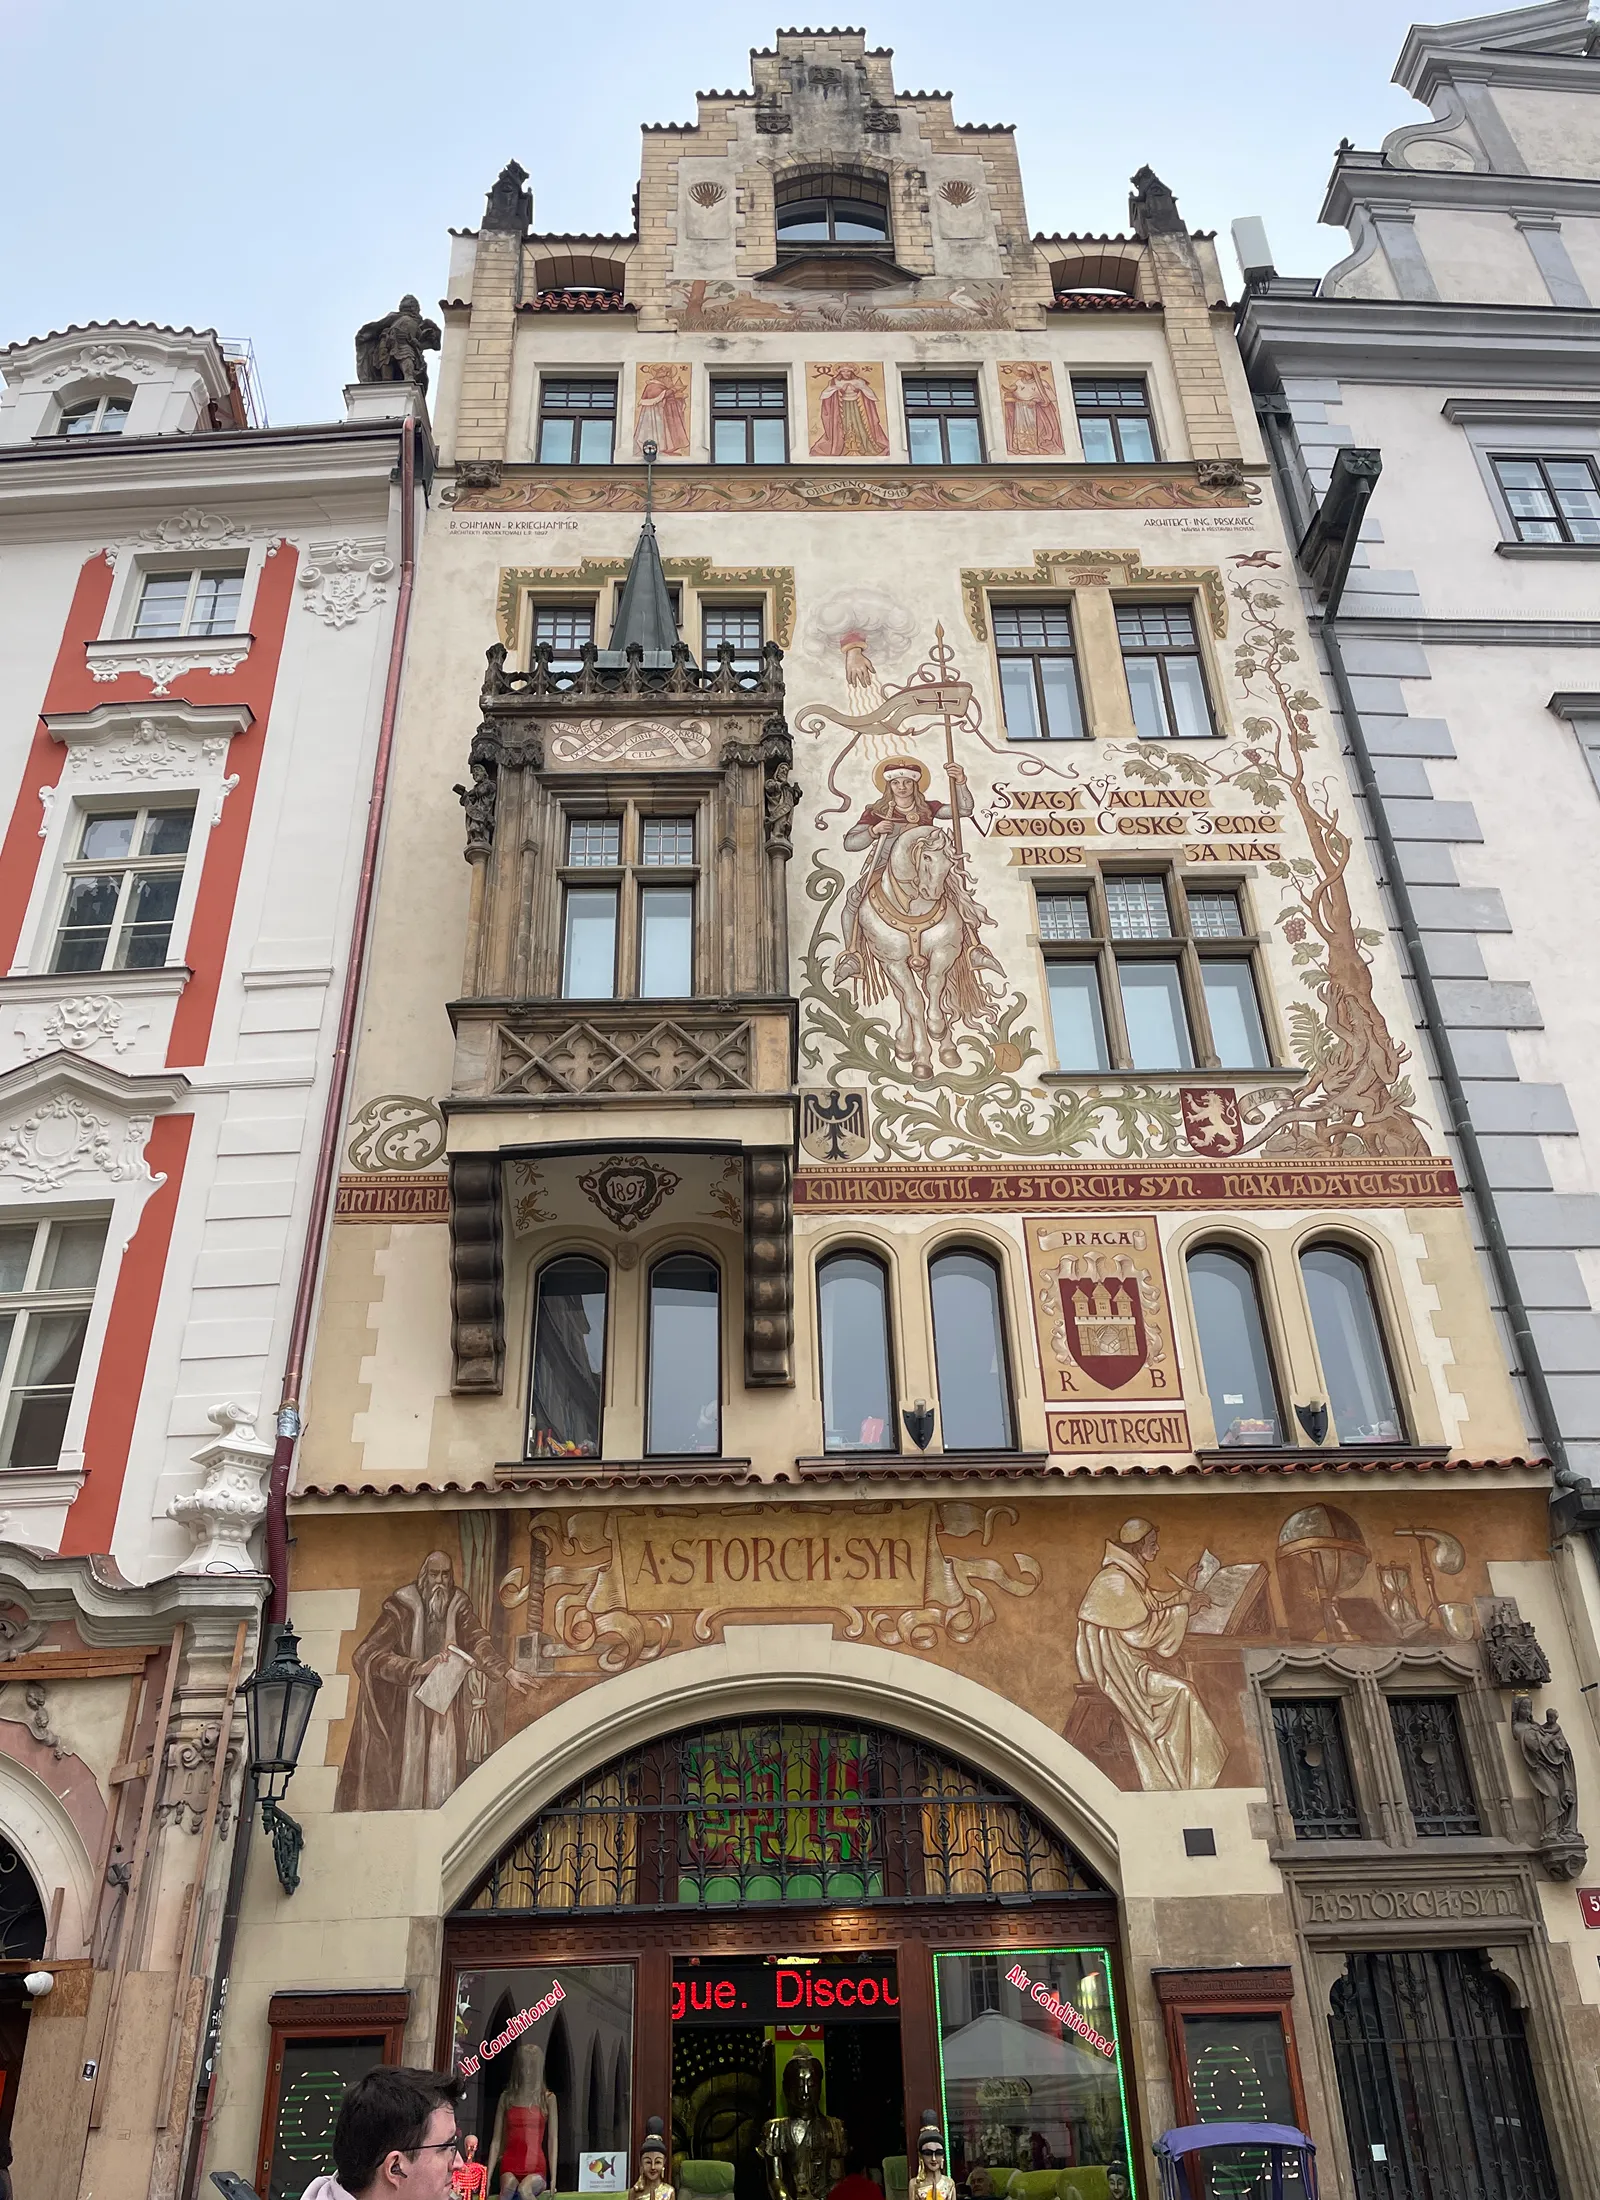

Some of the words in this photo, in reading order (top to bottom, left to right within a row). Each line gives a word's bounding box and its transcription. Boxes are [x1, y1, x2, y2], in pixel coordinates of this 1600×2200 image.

[1020, 846, 1083, 866] PROS
[1228, 839, 1281, 861] NÁS
[336, 1188, 449, 1212] ANTIKVARI
[609, 1180, 646, 1202] 1897
[1061, 1231, 1133, 1246] PRAGA
[1058, 1370, 1080, 1392] R
[1149, 1368, 1167, 1389] B
[1005, 1963, 1031, 1992] Air
[1030, 1981, 1117, 2058] Conditioned
[458, 2055, 481, 2078] Air
[479, 1979, 567, 2061] Conditioned
